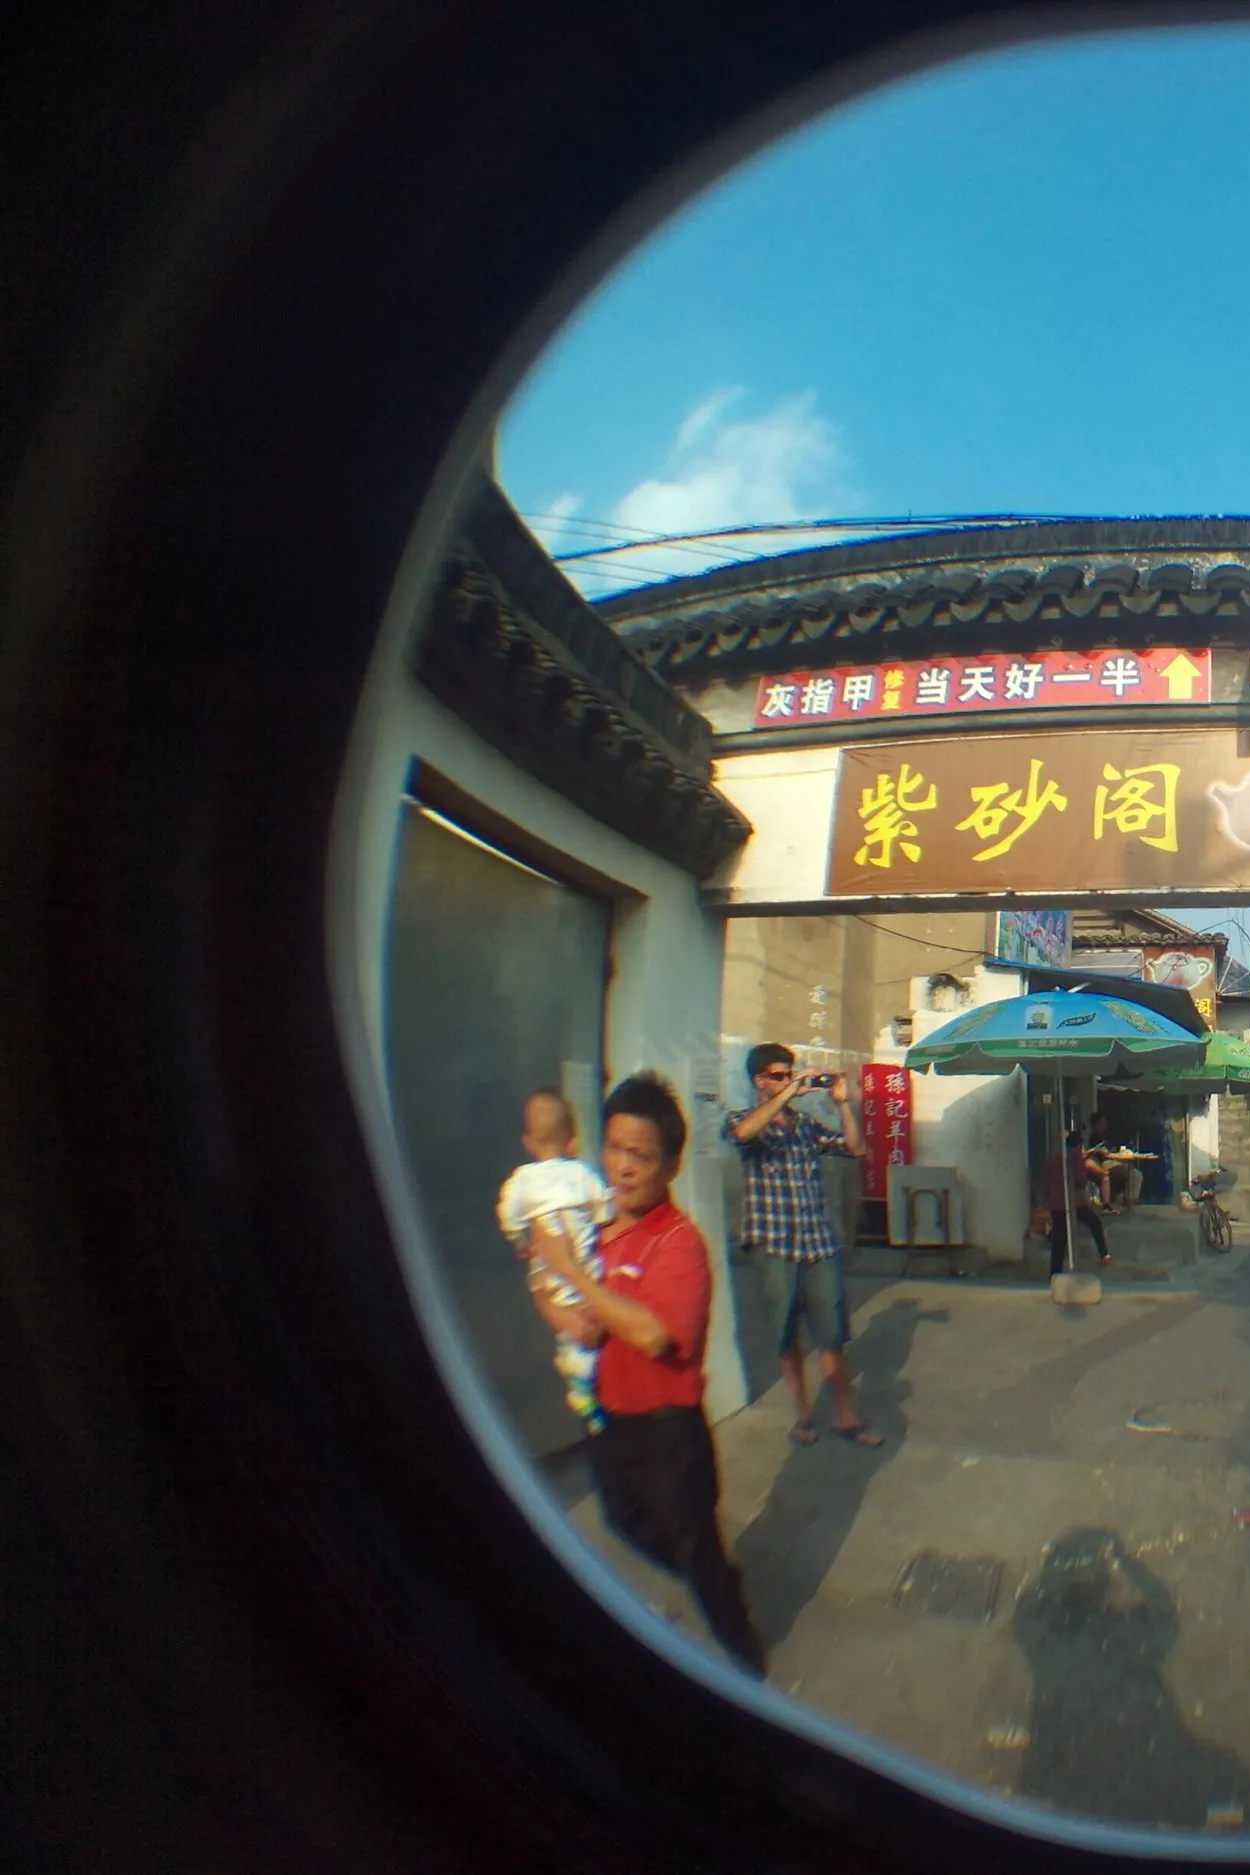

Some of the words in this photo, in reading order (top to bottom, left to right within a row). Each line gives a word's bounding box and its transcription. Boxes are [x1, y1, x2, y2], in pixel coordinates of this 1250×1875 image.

[761, 673, 875, 717] 灰指甲
[915, 658, 1140, 705] 当天好一半
[853, 758, 1181, 869] 紫砂阁
